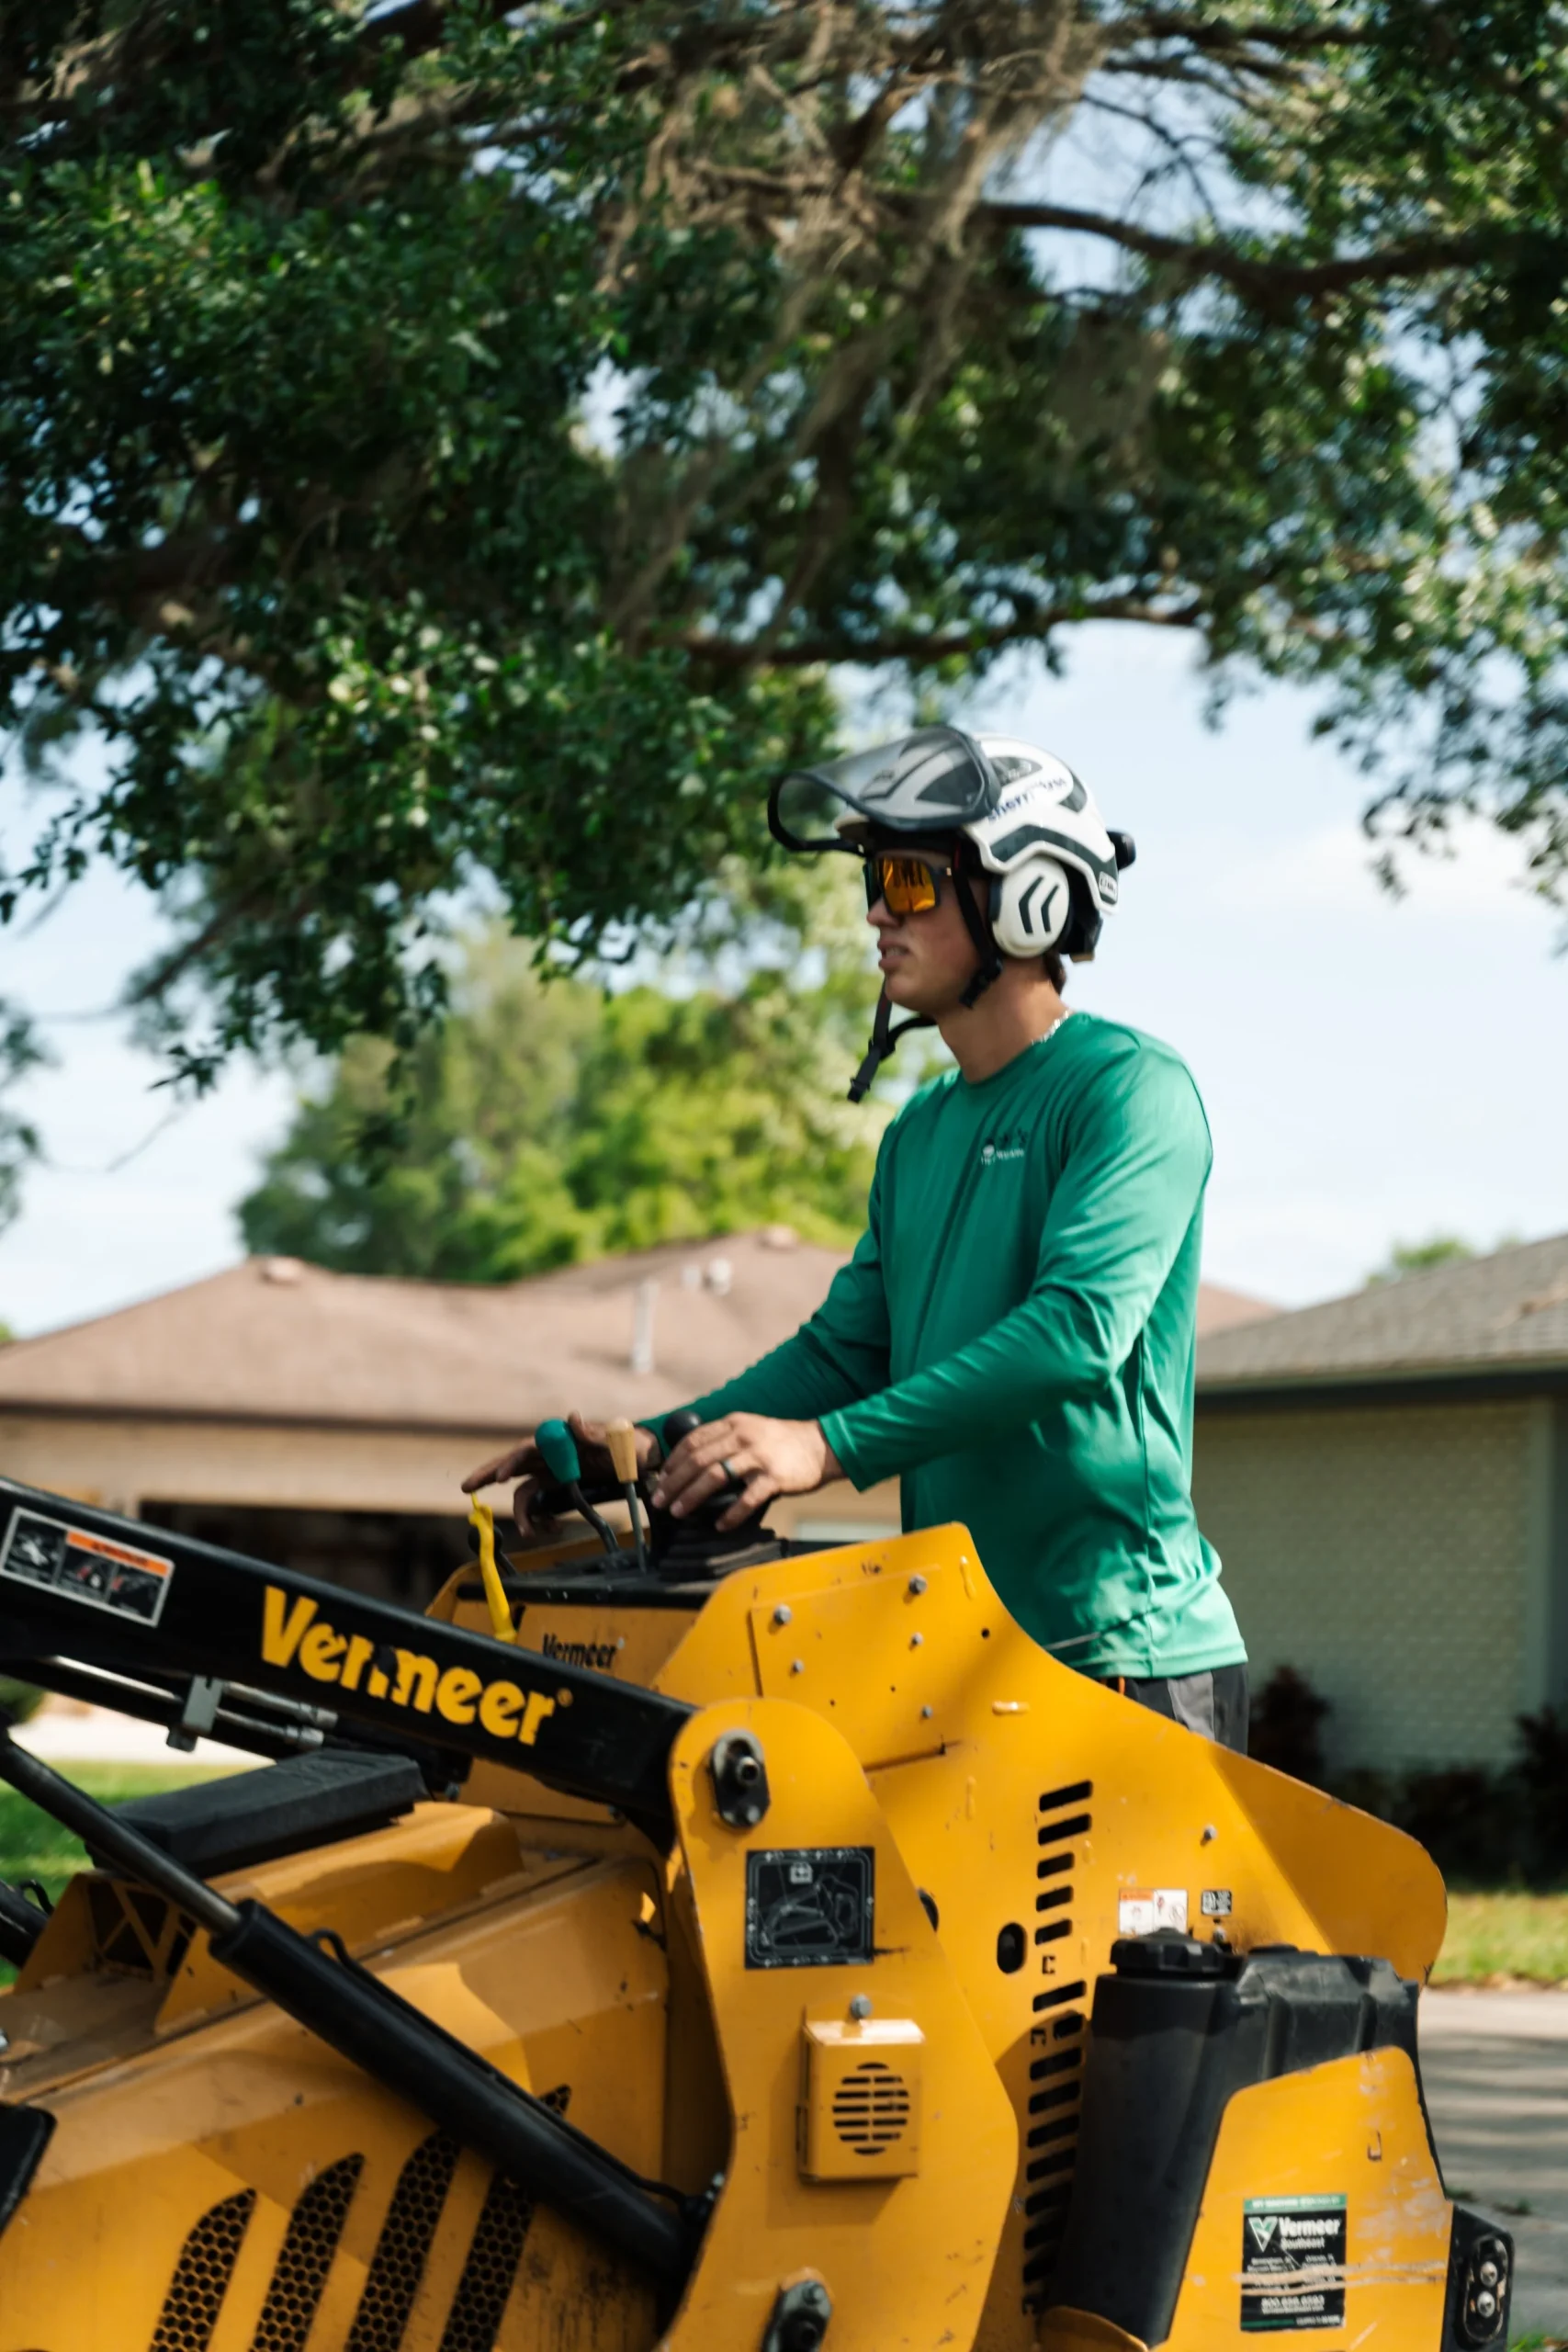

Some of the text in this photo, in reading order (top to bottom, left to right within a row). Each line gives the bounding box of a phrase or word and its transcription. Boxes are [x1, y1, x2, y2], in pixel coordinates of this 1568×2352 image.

[262, 1585, 556, 1746] Vermeer
[543, 1632, 617, 1668] Vermeer
[1278, 2215, 1340, 2238] Vermeer
